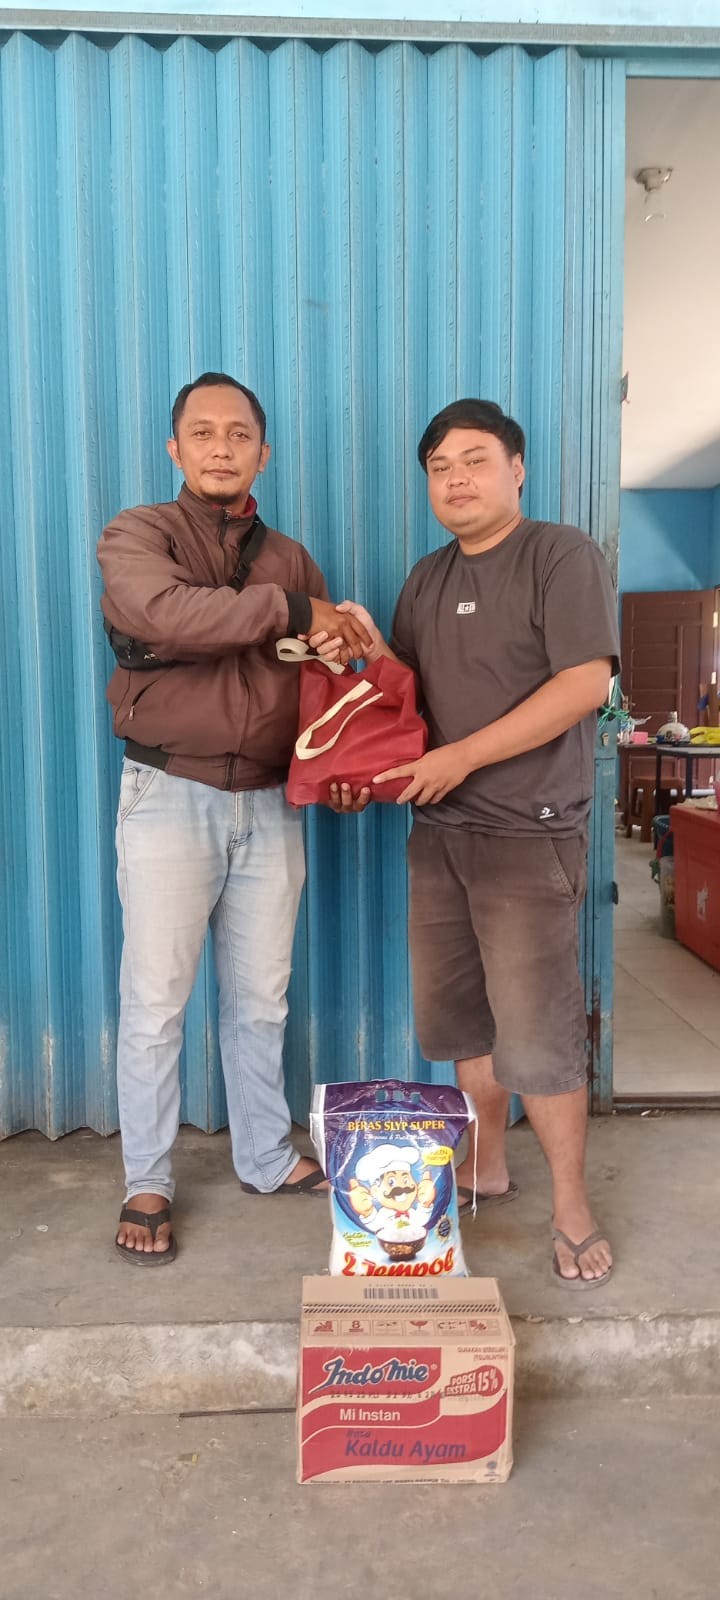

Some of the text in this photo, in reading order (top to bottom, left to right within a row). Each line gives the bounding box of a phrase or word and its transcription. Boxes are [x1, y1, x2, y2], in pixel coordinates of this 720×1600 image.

[348, 1119, 446, 1131] BERAS SLYP SUPER
[451, 1372, 477, 1386] PORSI
[446, 1382, 477, 1395] EKSTRA
[340, 1408, 401, 1421] Mi Instan
[344, 1439, 467, 1464] Kaldu Ayam
